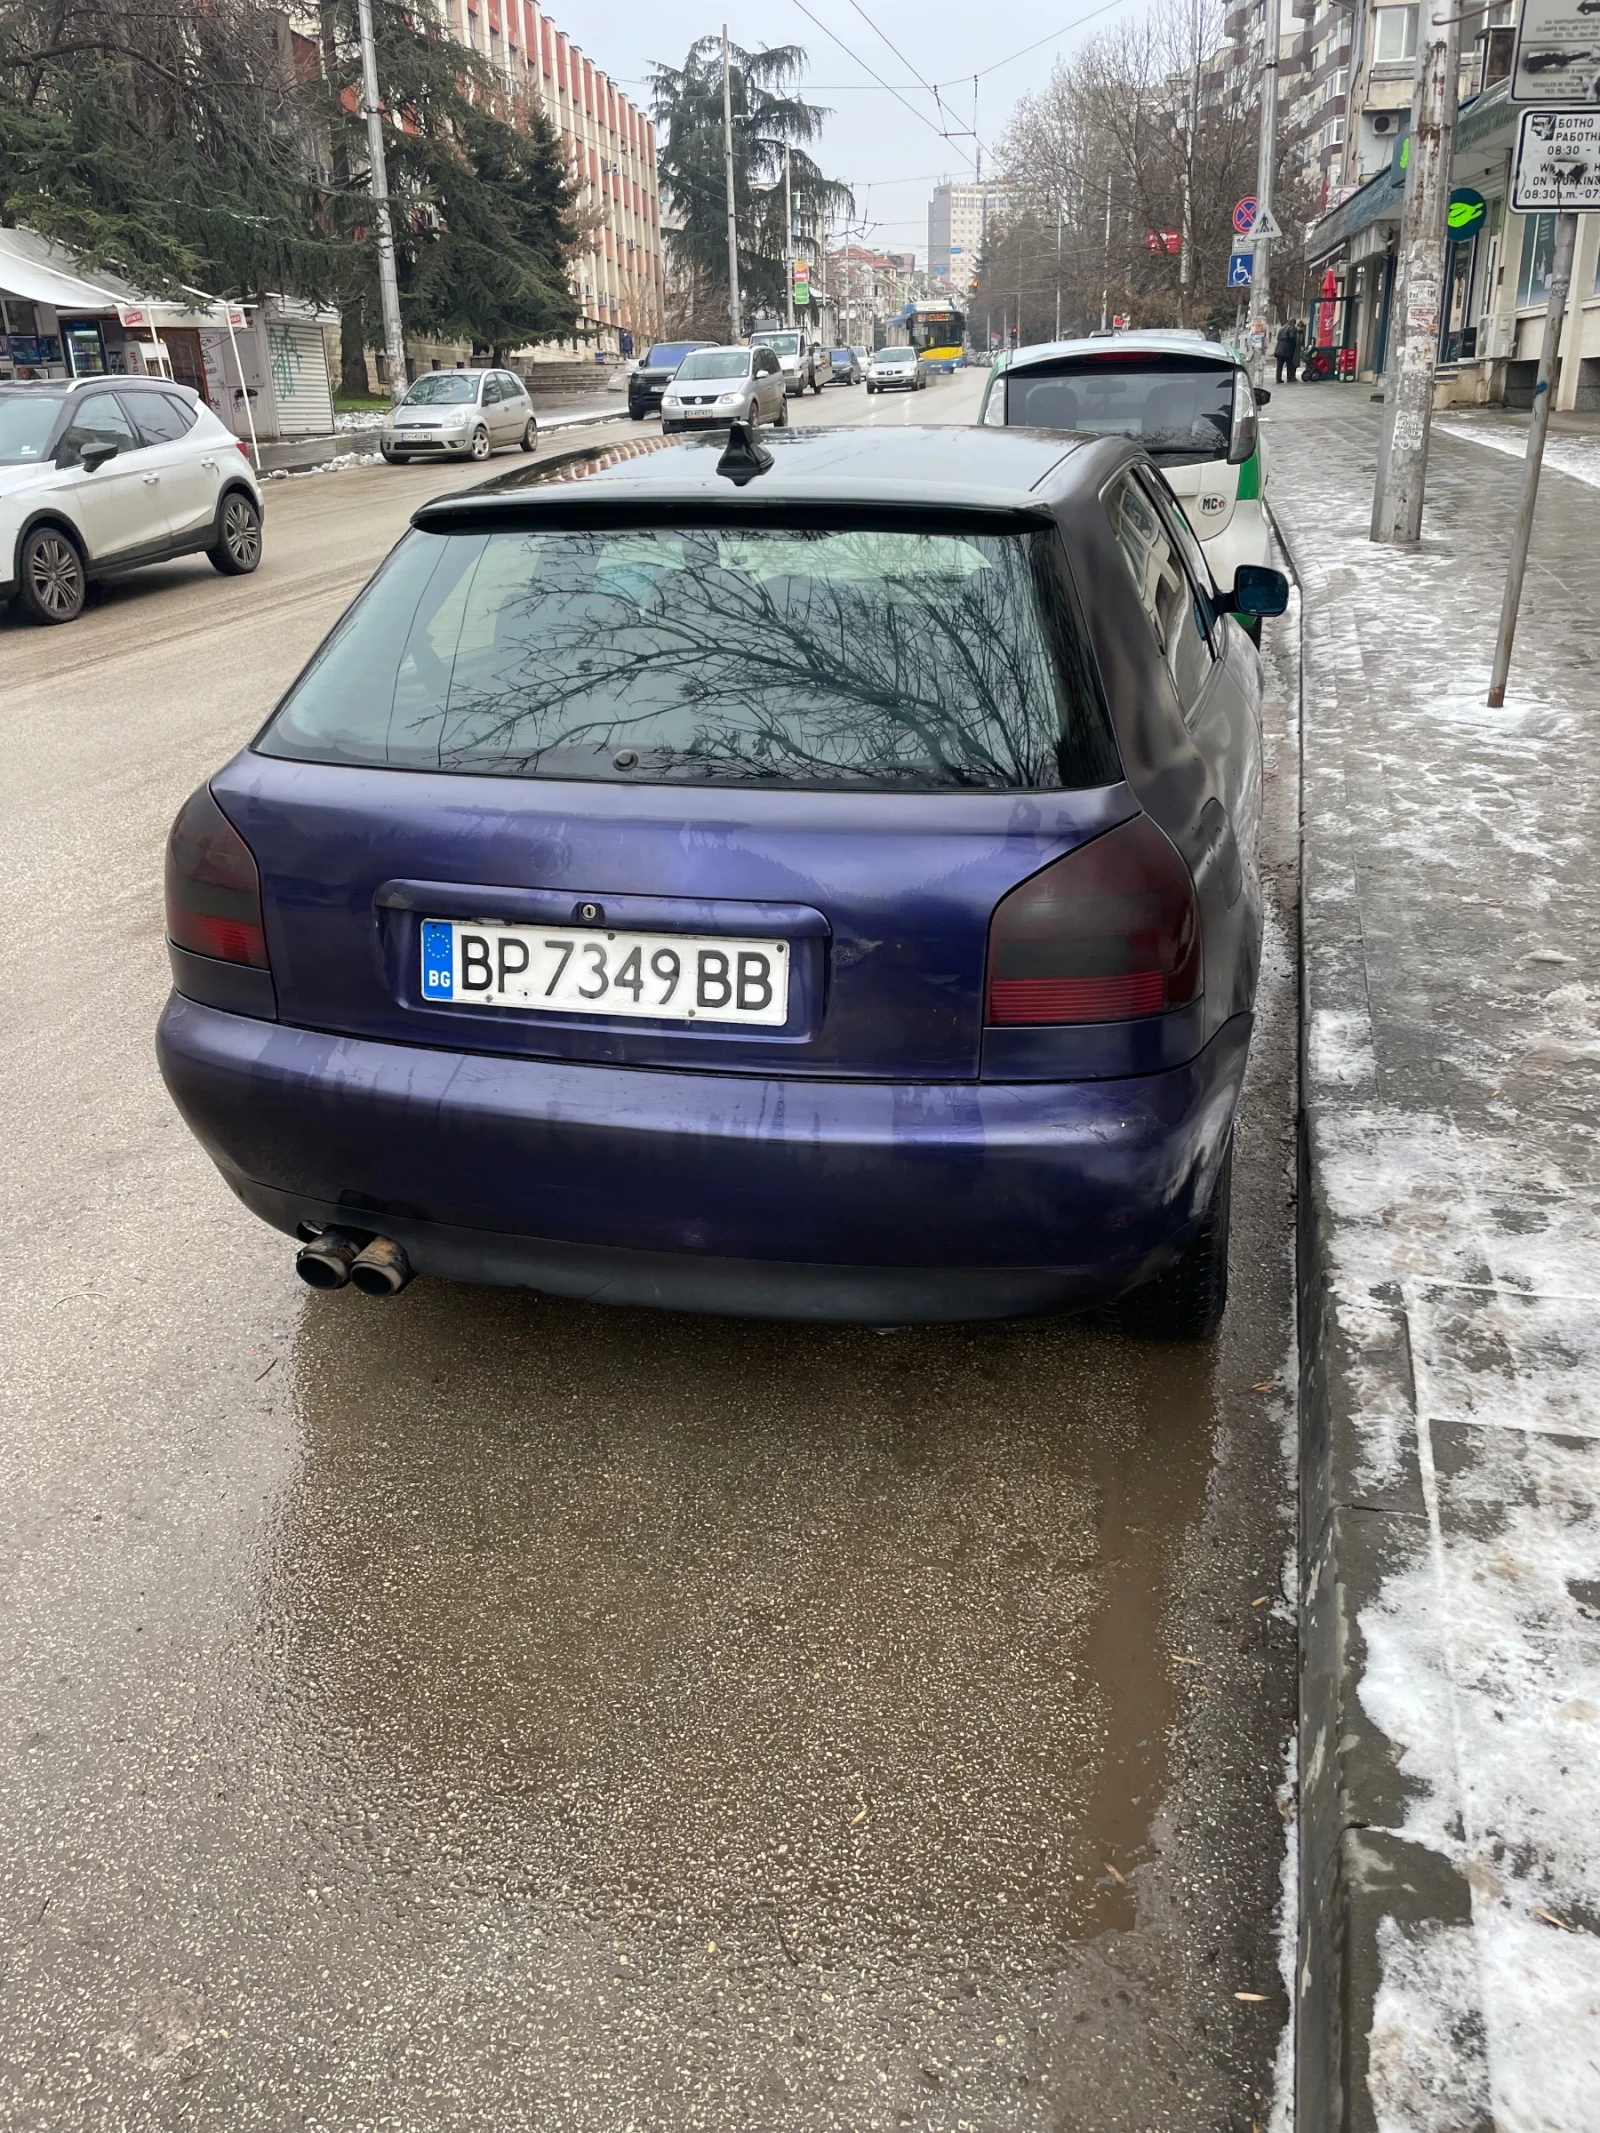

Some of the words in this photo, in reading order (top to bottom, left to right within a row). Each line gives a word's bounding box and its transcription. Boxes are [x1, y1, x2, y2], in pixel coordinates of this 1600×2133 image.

[1547, 145, 1580, 156] 08:30
[1533, 176, 1547, 186] ON
[1202, 497, 1218, 510] MC
[428, 970, 451, 988] BG
[461, 934, 530, 993] BP
[543, 939, 681, 1005] 7349
[696, 949, 773, 1010] BB
